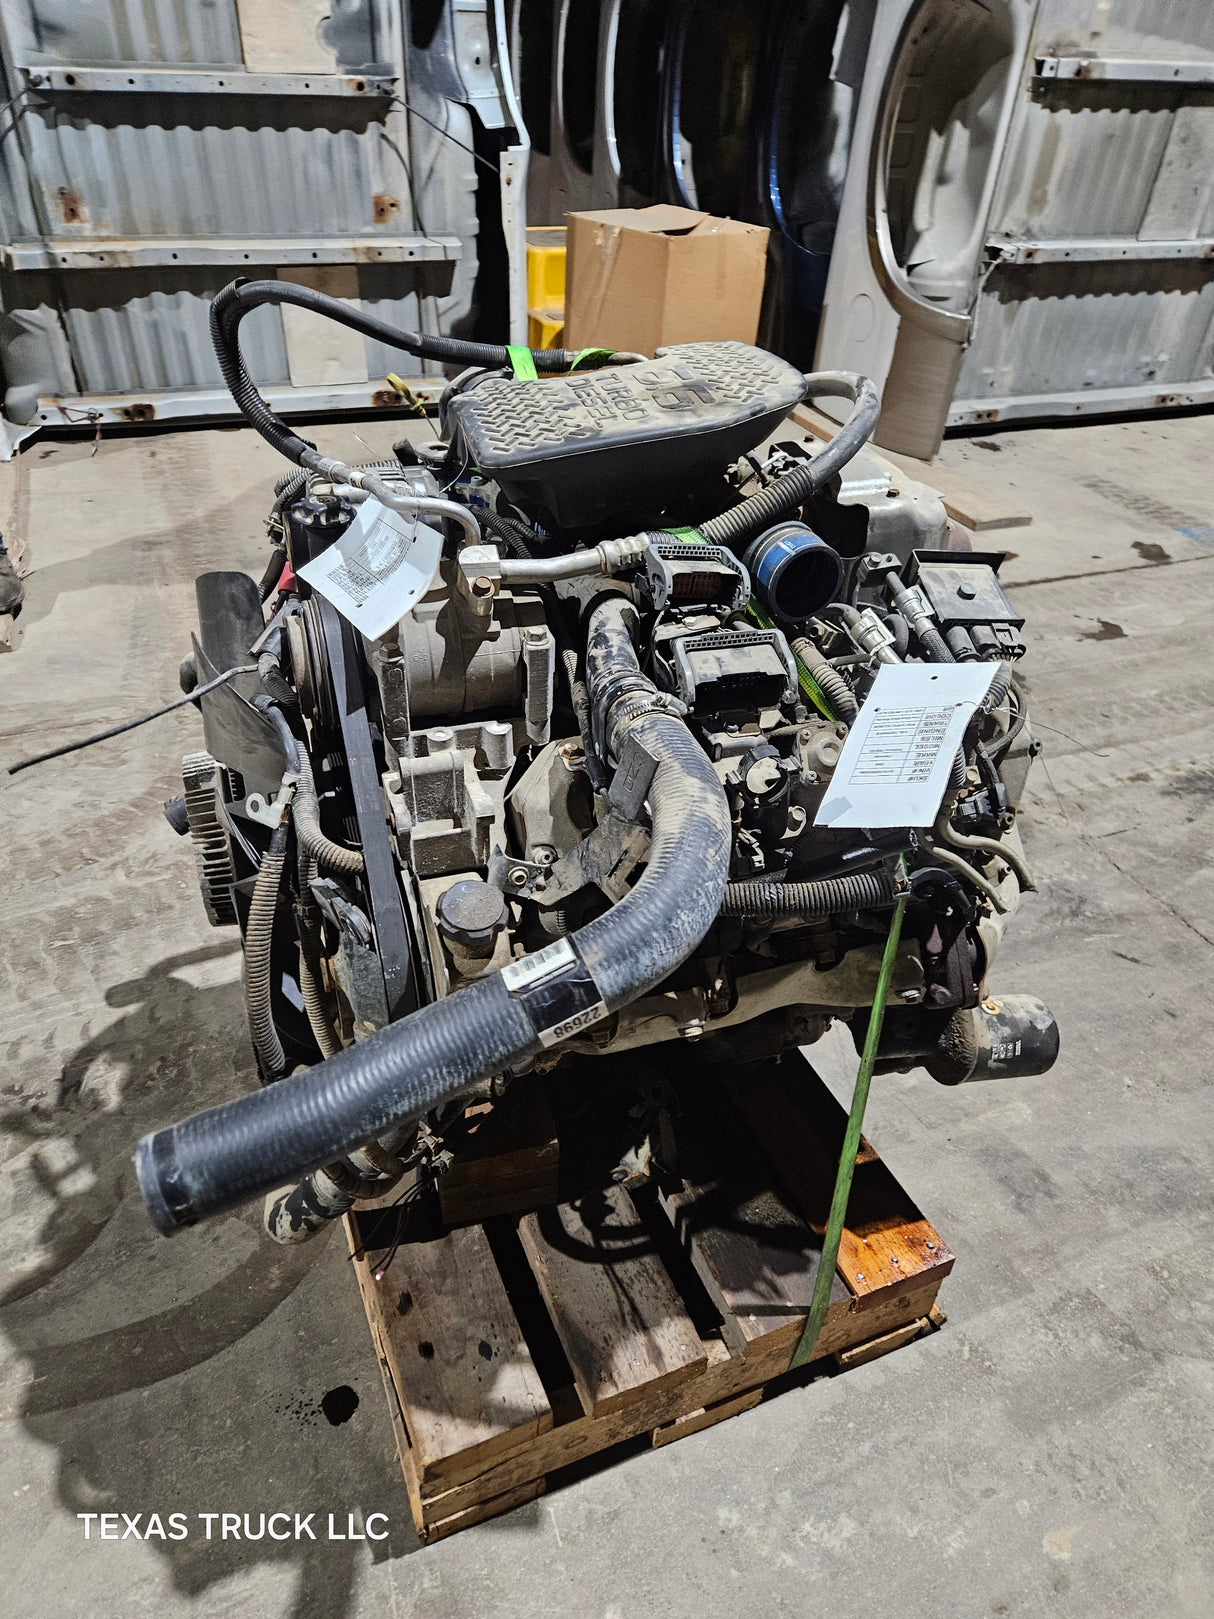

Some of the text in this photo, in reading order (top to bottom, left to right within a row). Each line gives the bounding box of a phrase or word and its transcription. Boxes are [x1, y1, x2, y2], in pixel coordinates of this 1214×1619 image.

[565, 377, 619, 429] DIESEL
[596, 373, 651, 421] TURBO
[554, 1008, 601, 1038] 22698
